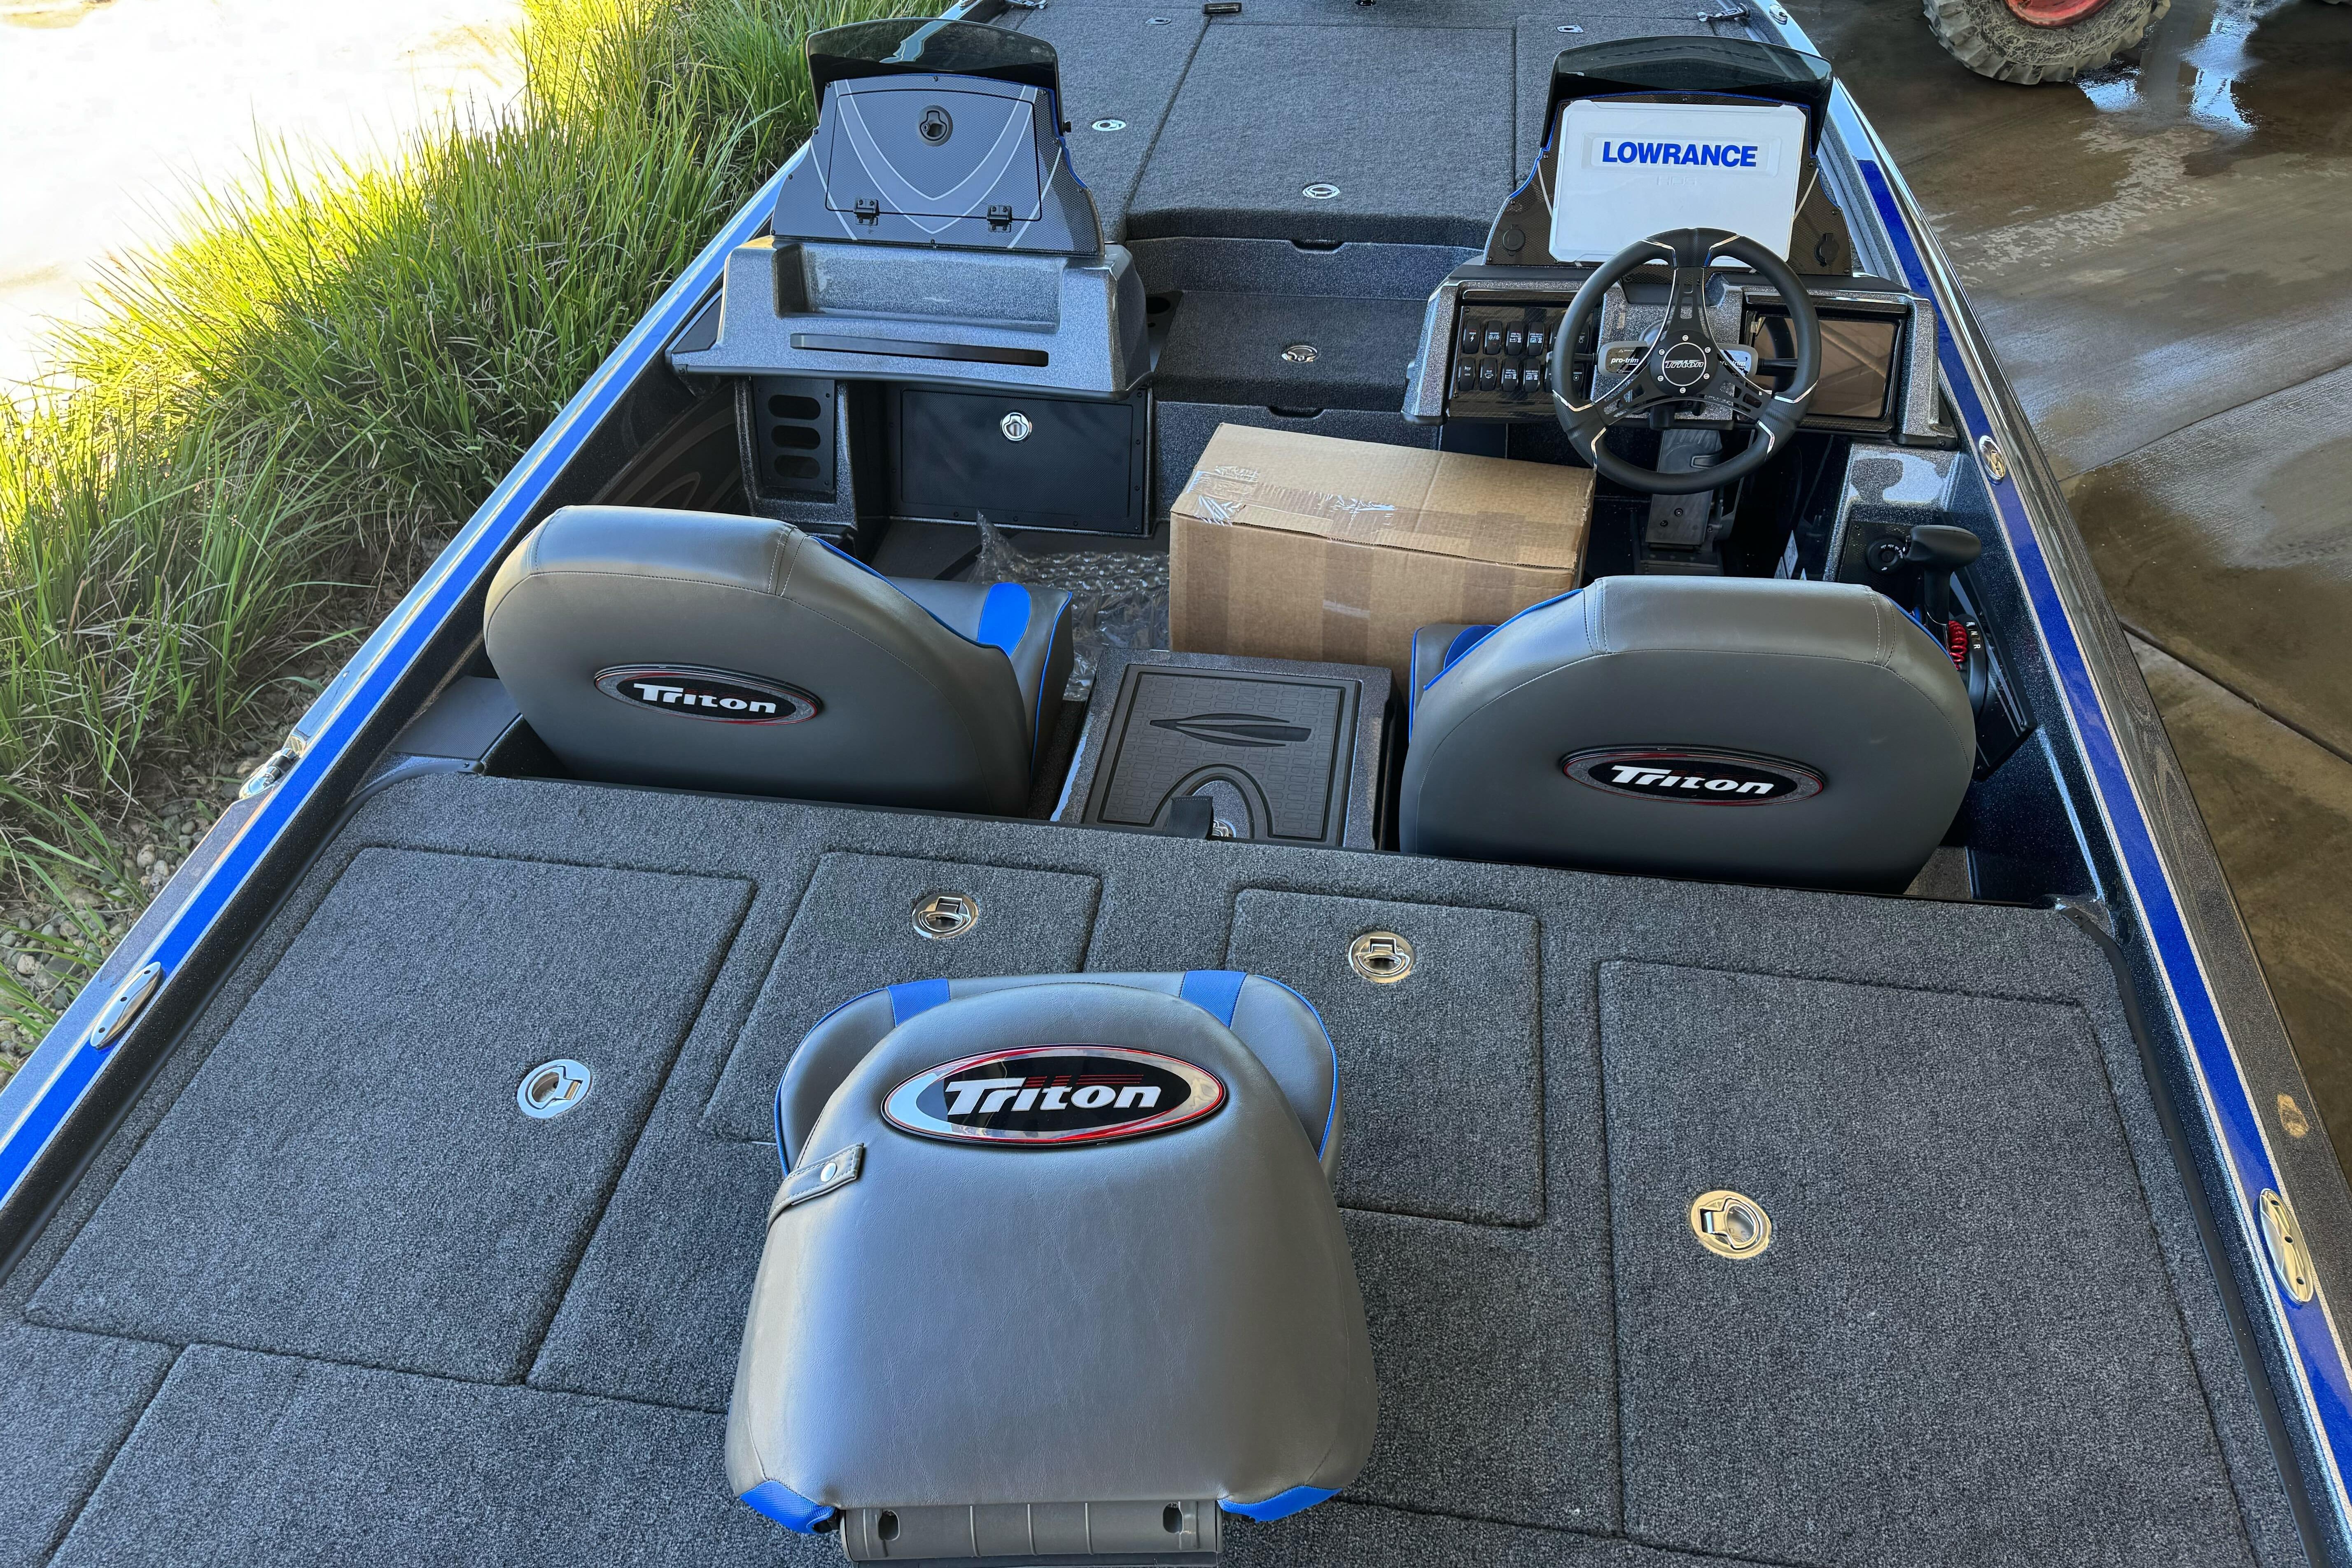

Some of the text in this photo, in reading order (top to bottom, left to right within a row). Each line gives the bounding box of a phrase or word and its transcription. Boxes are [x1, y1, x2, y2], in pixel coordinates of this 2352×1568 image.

[1602, 141, 1758, 167] LOWRANCE
[1665, 360, 1704, 369] Triton
[633, 683, 777, 713] Triton
[1610, 765, 1774, 794] Triton
[945, 1076, 1162, 1115] Triton
